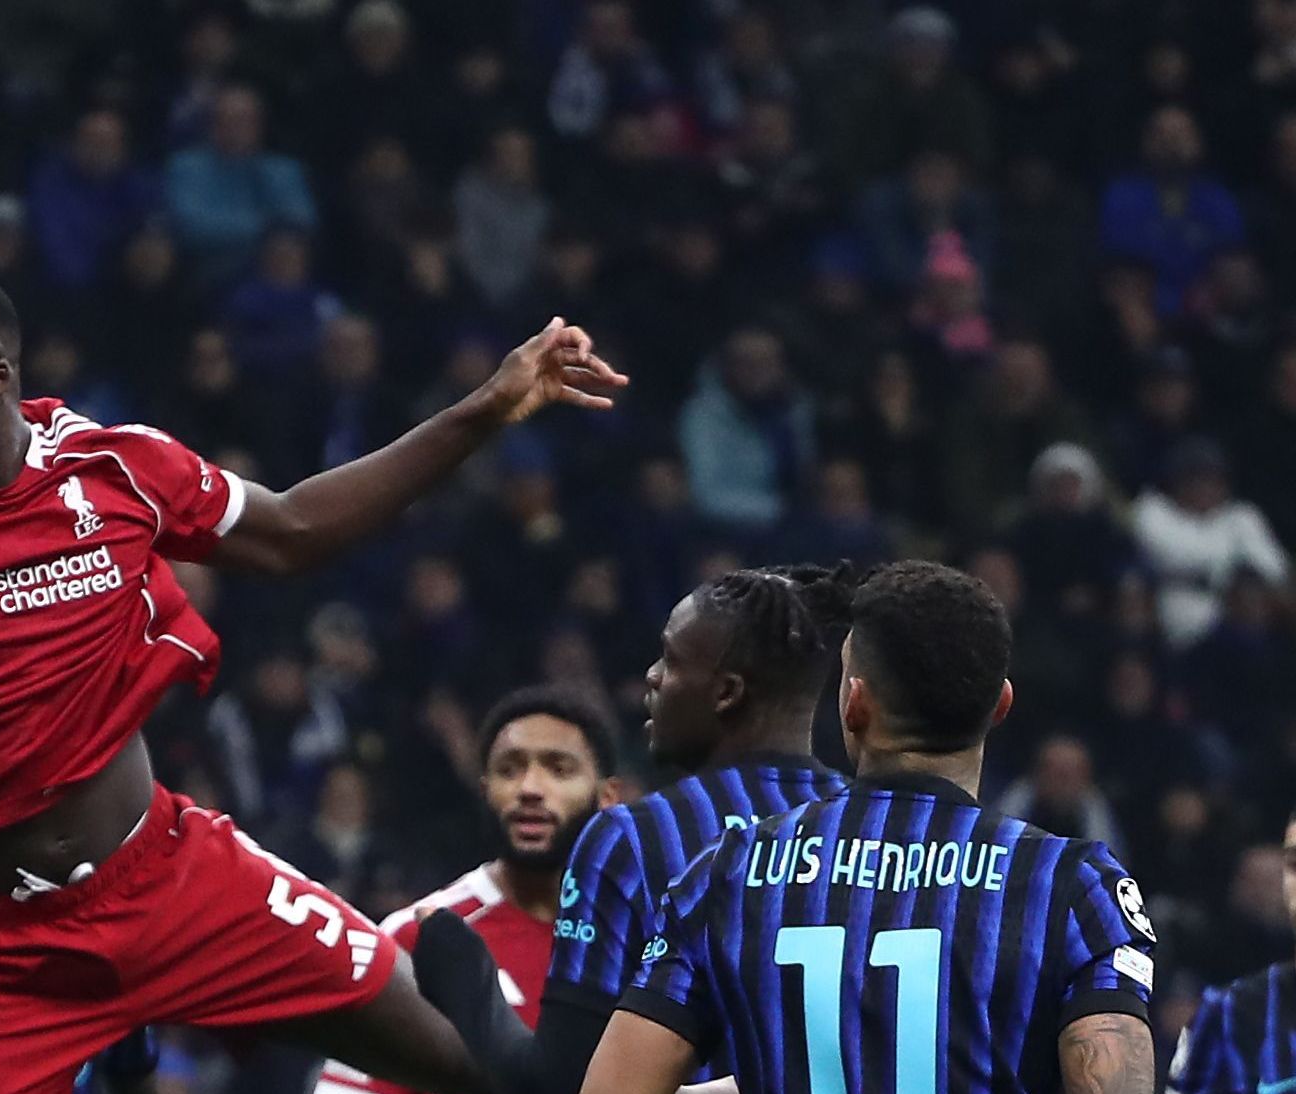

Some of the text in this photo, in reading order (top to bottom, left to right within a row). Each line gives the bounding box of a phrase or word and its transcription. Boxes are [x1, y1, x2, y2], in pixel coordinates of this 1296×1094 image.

[0, 565, 123, 614] chartered
[746, 825, 1009, 893] LUÍS HENRIQUE
[267, 874, 345, 948] 5
